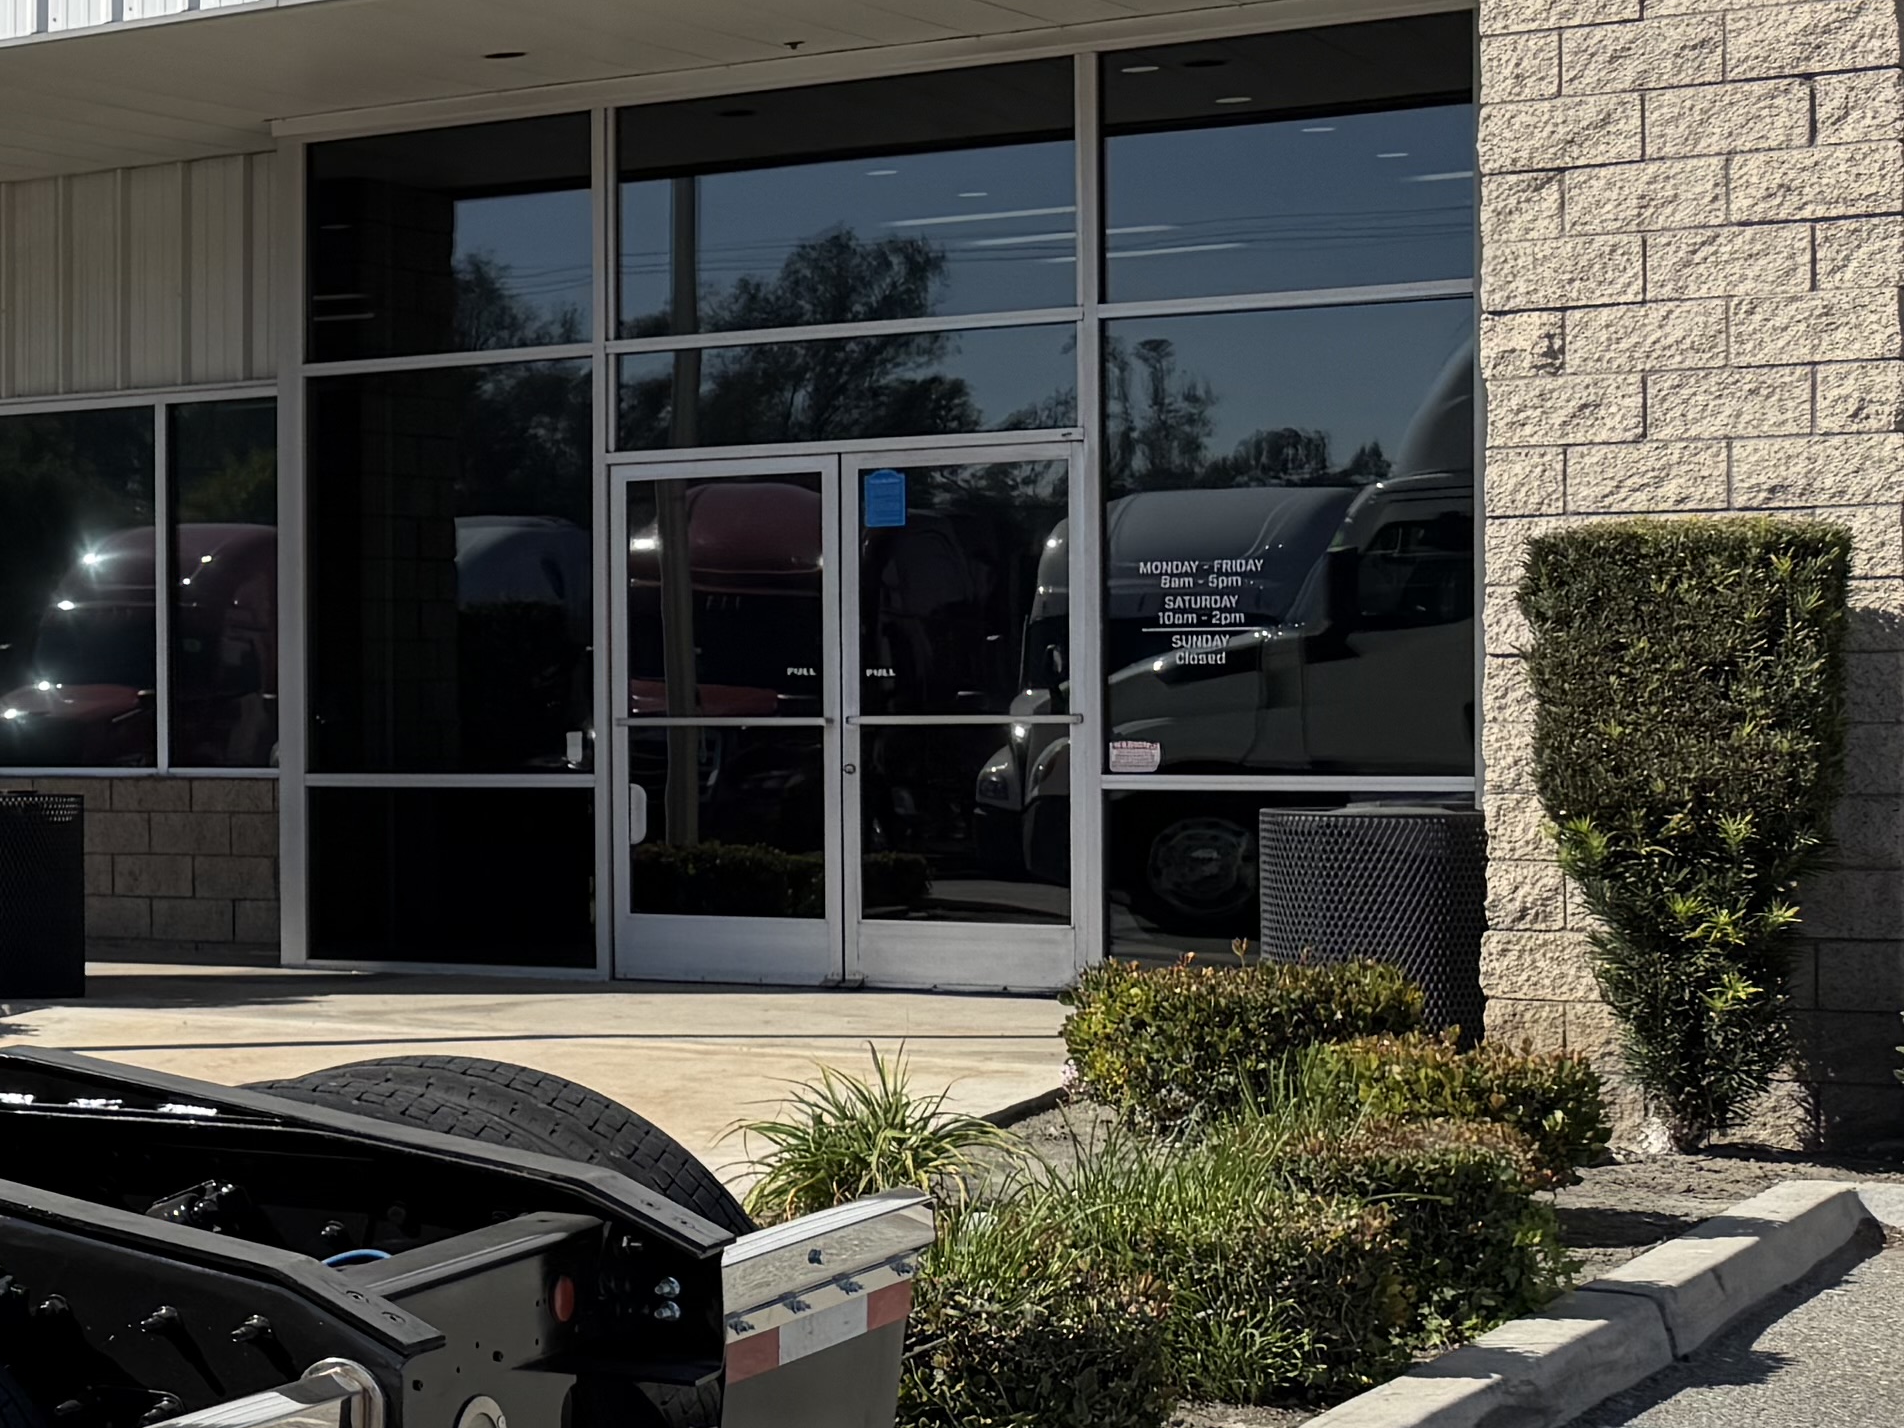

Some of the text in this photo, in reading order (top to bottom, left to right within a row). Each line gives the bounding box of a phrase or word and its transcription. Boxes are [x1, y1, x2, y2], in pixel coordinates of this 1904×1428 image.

[1139, 560, 1199, 575] MONDAY
[1213, 559, 1264, 573] FRIDAY
[1208, 575, 1242, 590] 5pm
[1164, 595, 1239, 609] SATURDAY
[1158, 611, 1198, 625] 10am
[1212, 611, 1245, 626] 2pm
[1171, 634, 1230, 649] SUNDAY
[1175, 651, 1226, 665] Closed
